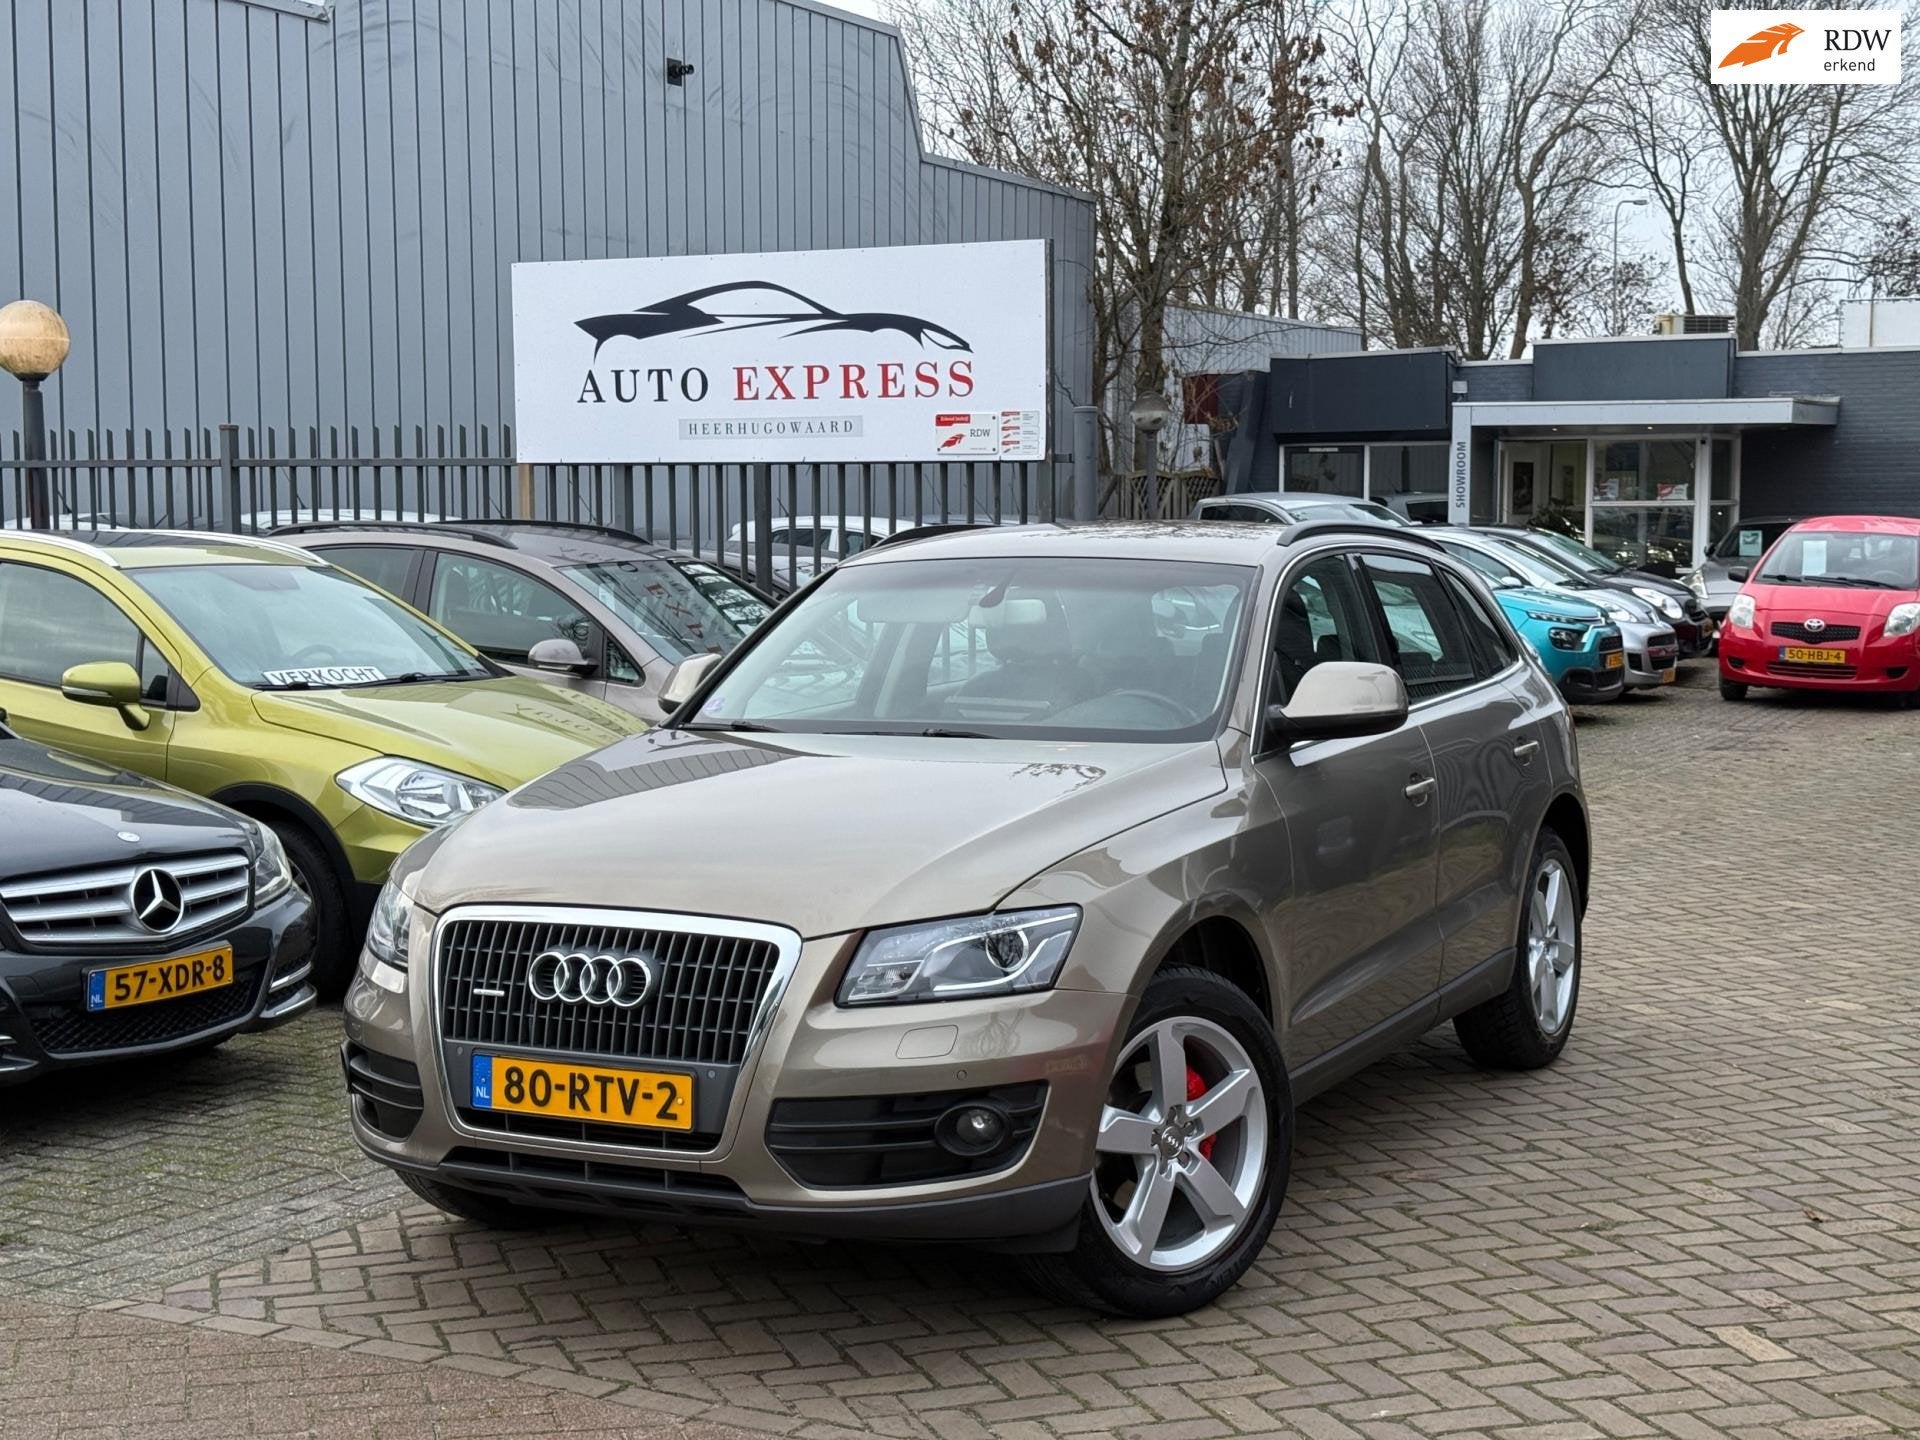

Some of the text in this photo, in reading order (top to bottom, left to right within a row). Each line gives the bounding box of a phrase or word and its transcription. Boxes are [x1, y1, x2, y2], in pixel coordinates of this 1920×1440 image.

[576, 360, 975, 403] AUTO EXPRESS
[688, 420, 854, 435] HEERHUGOWAARD
[969, 428, 991, 438] RDW
[1455, 441, 1467, 509] SHOWROOM
[1788, 649, 1842, 662] 50-HBJ-4
[270, 667, 380, 686] VERKOCHT
[114, 954, 225, 1002] 57-XDR-8
[475, 1066, 678, 1121] NL 80-RTV-2
